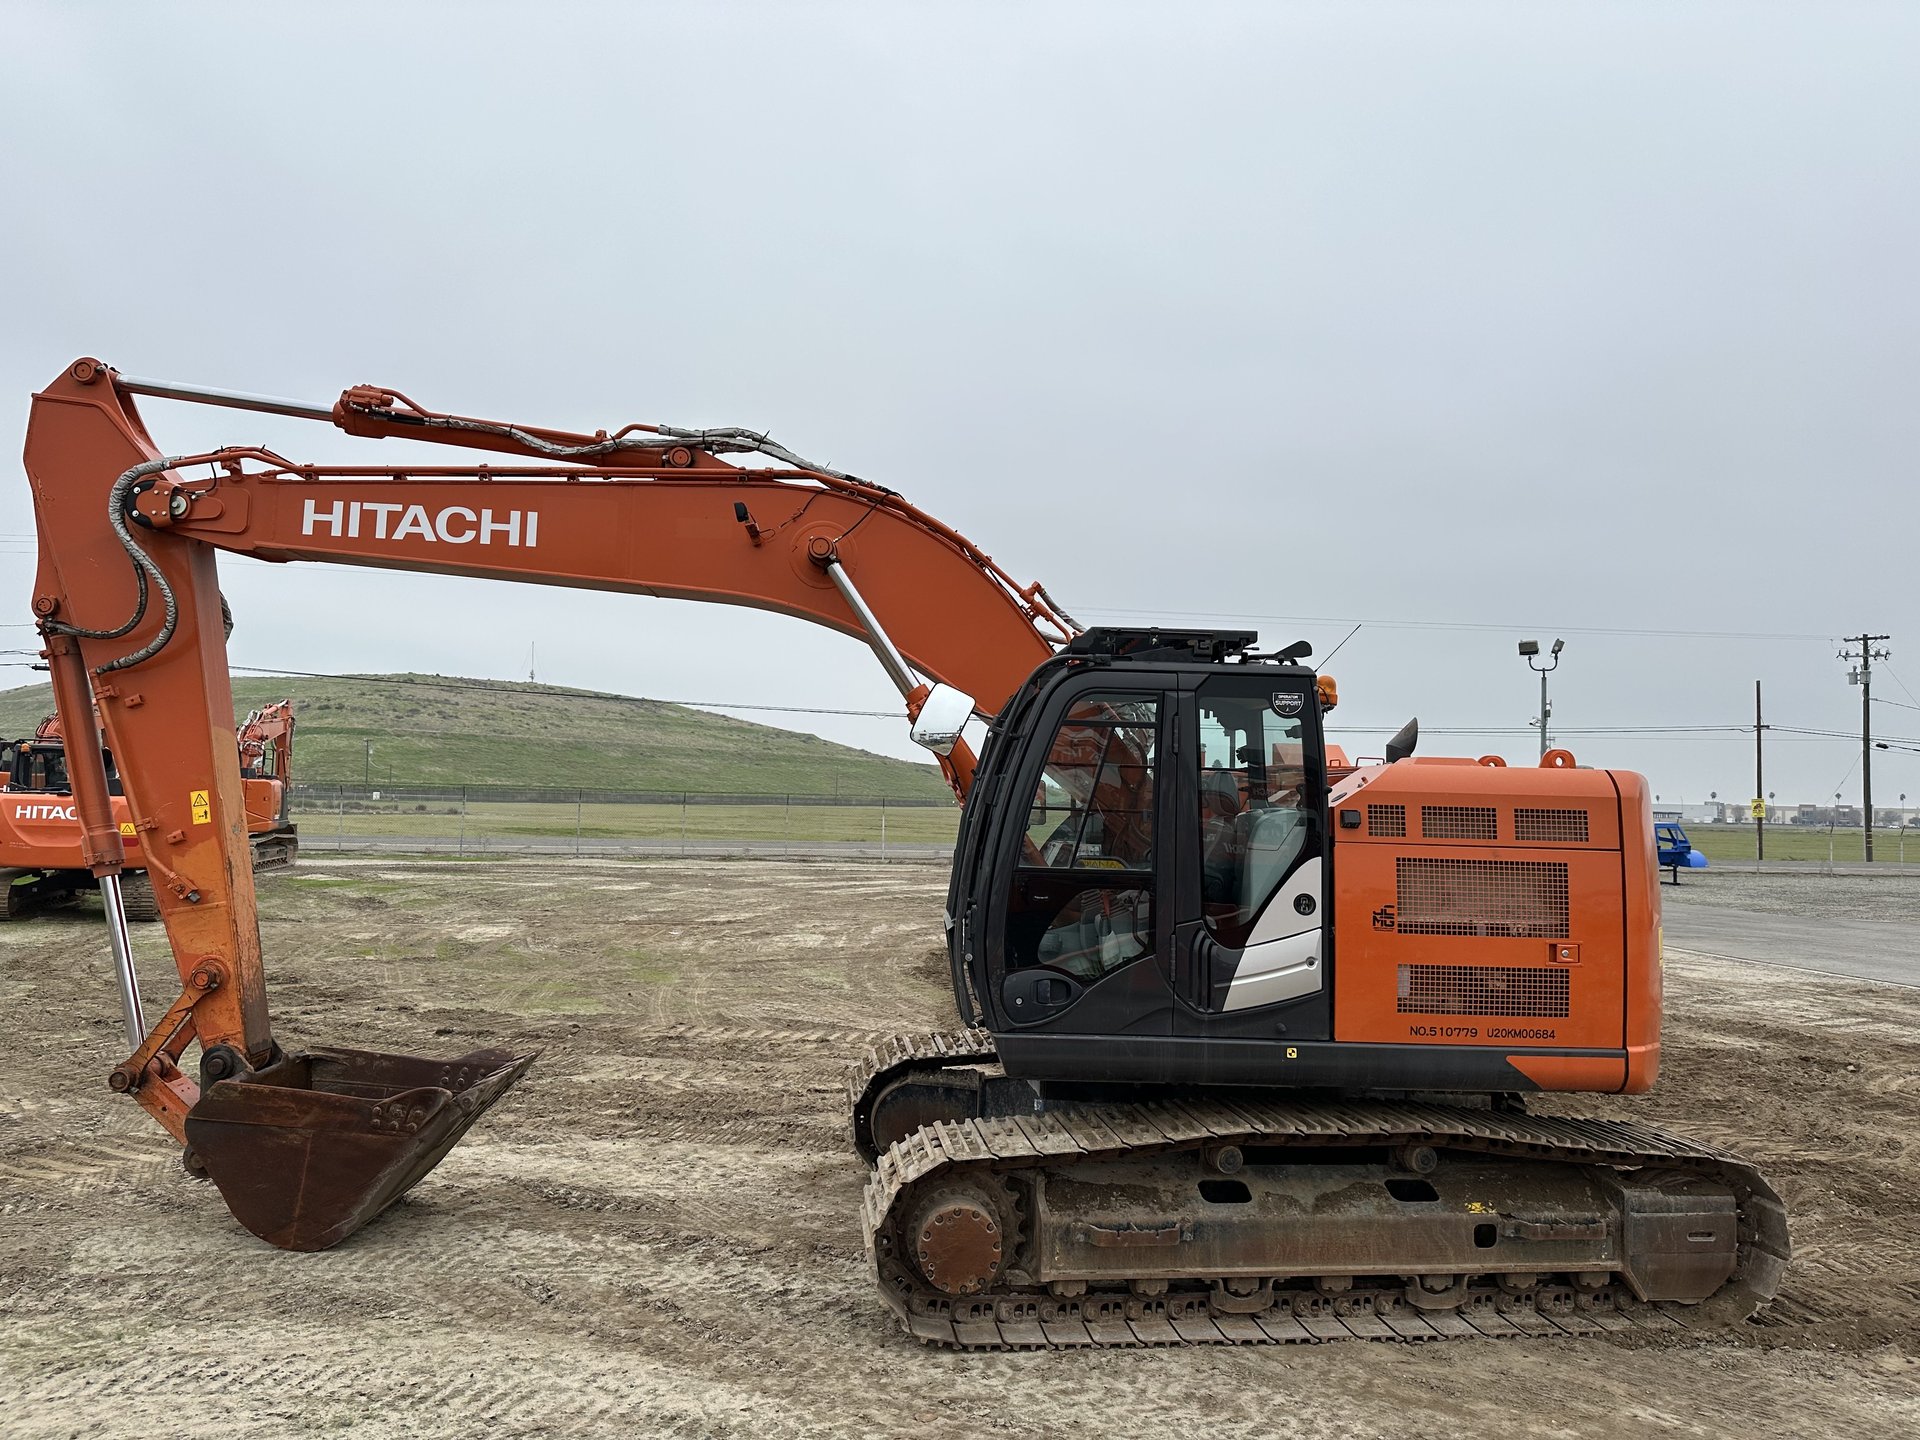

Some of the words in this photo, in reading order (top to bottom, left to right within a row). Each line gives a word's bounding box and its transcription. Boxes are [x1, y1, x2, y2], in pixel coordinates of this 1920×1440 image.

[302, 499, 538, 547] HITACHI
[1410, 1026, 1478, 1037] NO.510779
[1487, 1028, 1556, 1039] U20KM00684
